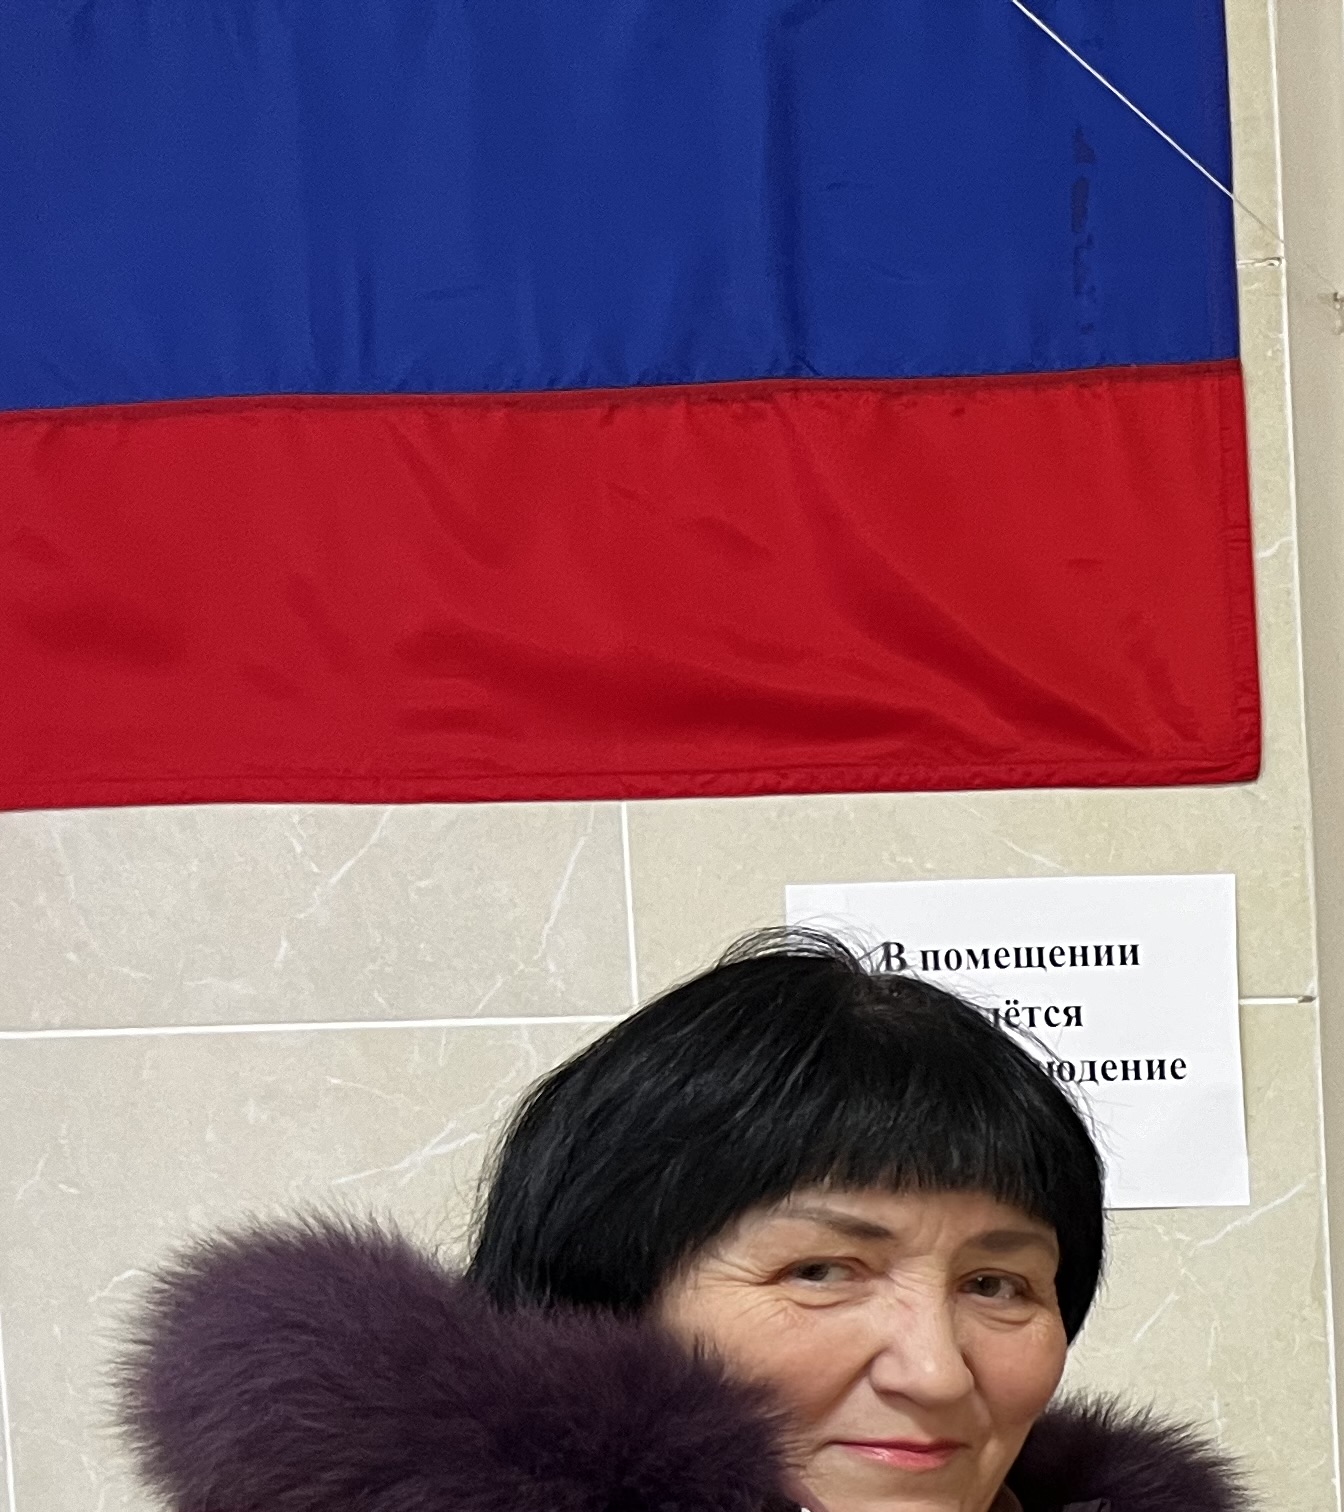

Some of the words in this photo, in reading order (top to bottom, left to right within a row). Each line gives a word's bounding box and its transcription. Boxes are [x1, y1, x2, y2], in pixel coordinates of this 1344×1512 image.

[882, 941, 908, 972] В
[919, 943, 1140, 973] помещении
[991, 999, 1084, 1028] ётся
